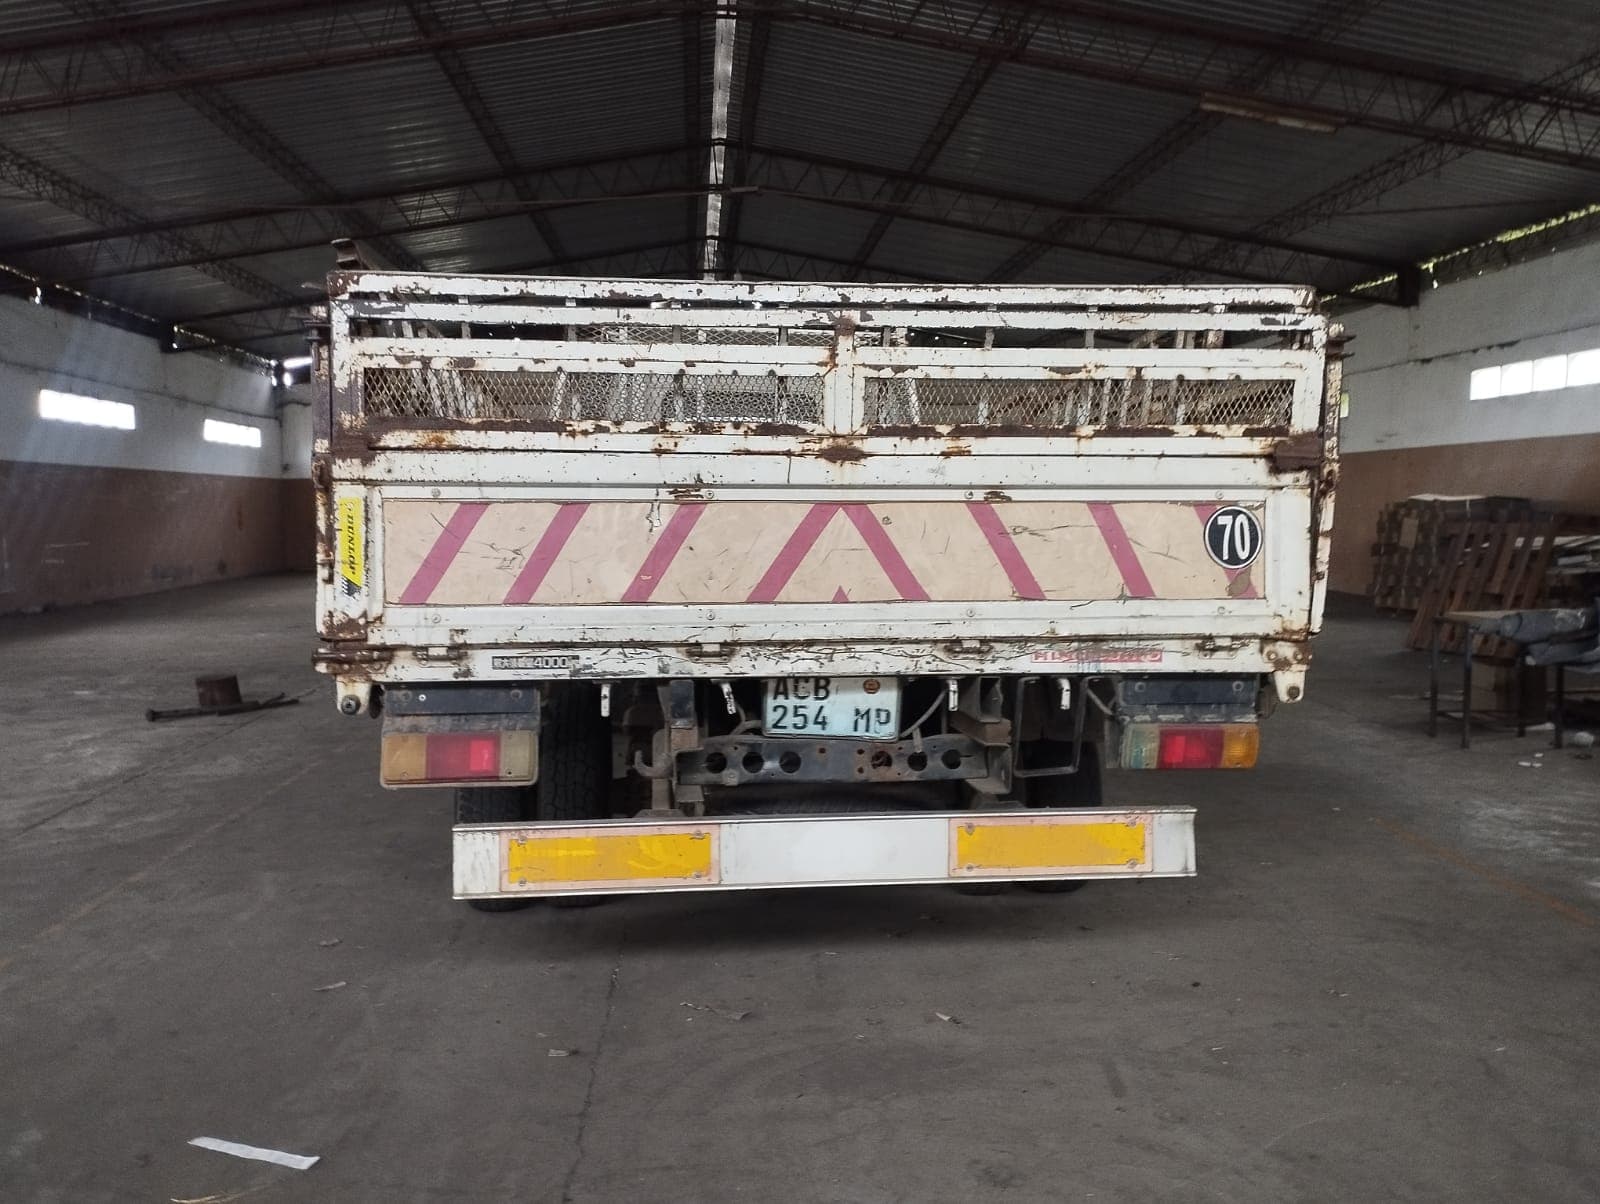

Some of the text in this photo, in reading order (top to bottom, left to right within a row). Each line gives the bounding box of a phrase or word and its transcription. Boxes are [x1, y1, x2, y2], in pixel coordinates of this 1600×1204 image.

[346, 514, 357, 575] DUNLOP
[1217, 513, 1251, 561] 70
[773, 677, 832, 701] ACB
[771, 704, 828, 731] 254
